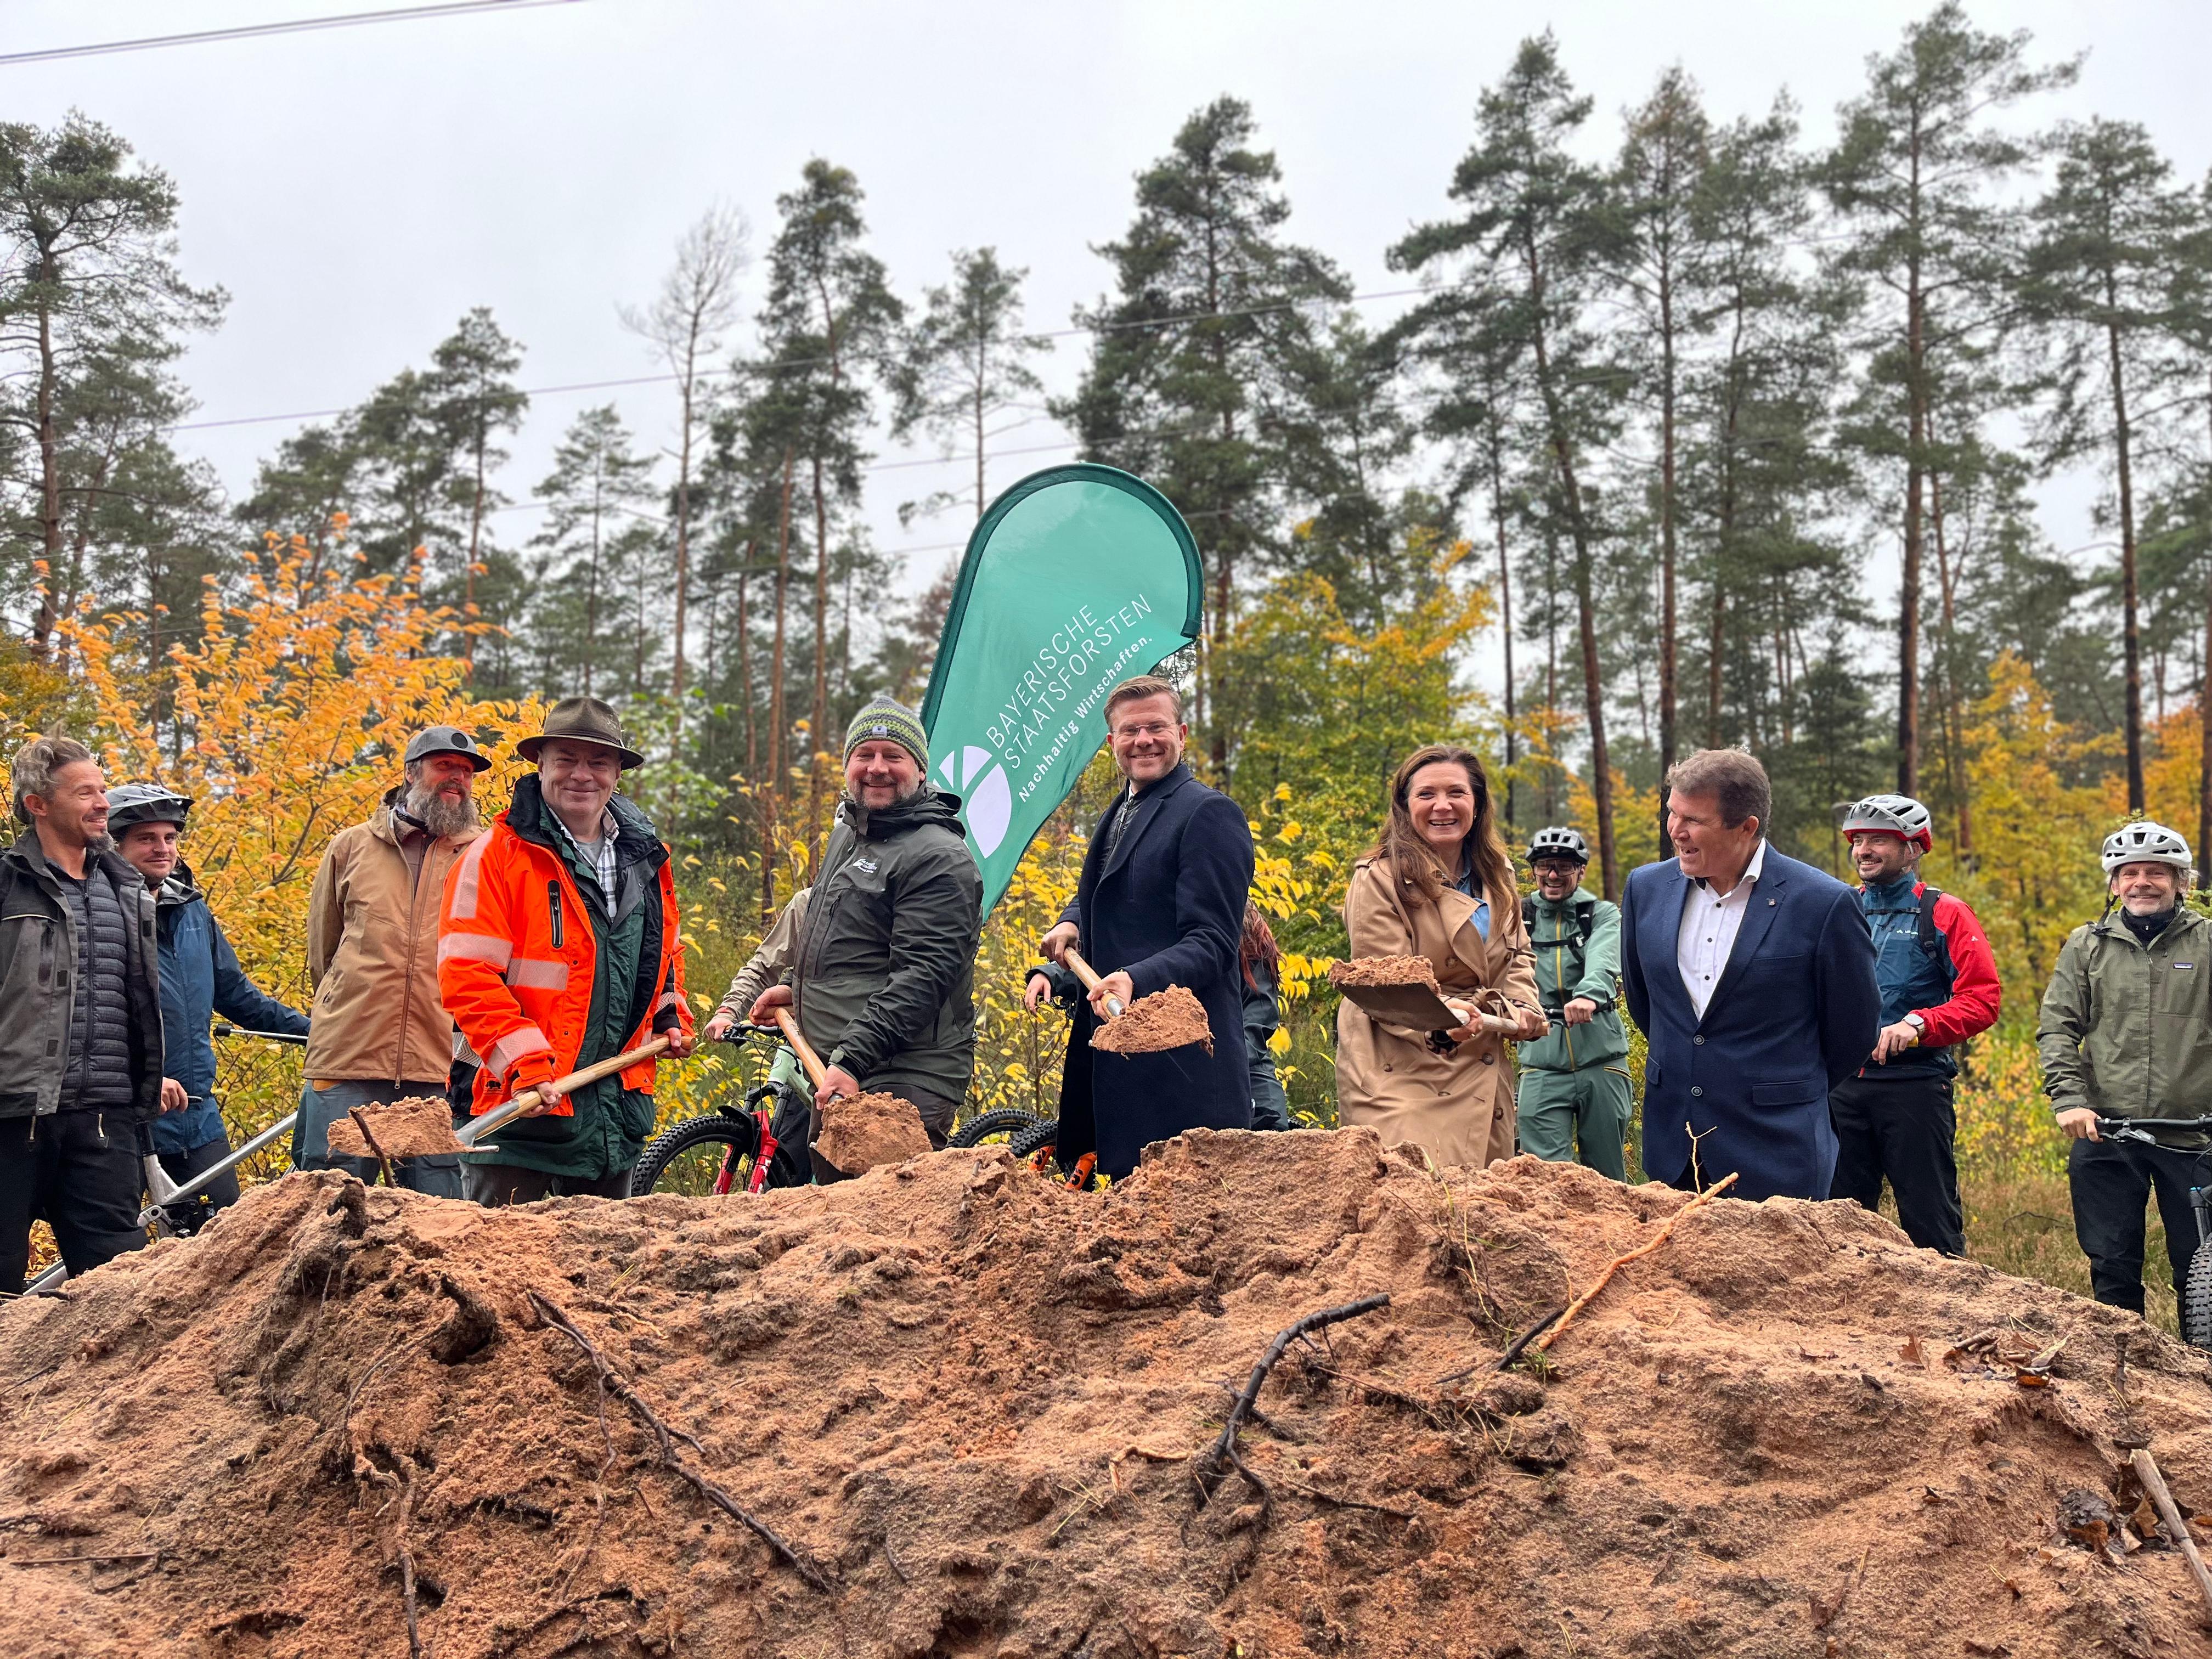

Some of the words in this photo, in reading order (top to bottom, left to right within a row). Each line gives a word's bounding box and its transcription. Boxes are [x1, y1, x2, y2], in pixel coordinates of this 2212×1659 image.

[986, 605, 1098, 749] BAYERISCHE
[1005, 594, 1152, 769] STAATSFORSTEN
[1018, 719, 1080, 803] Nachhaltig
[1074, 637, 1153, 719] Wirtschaften.
